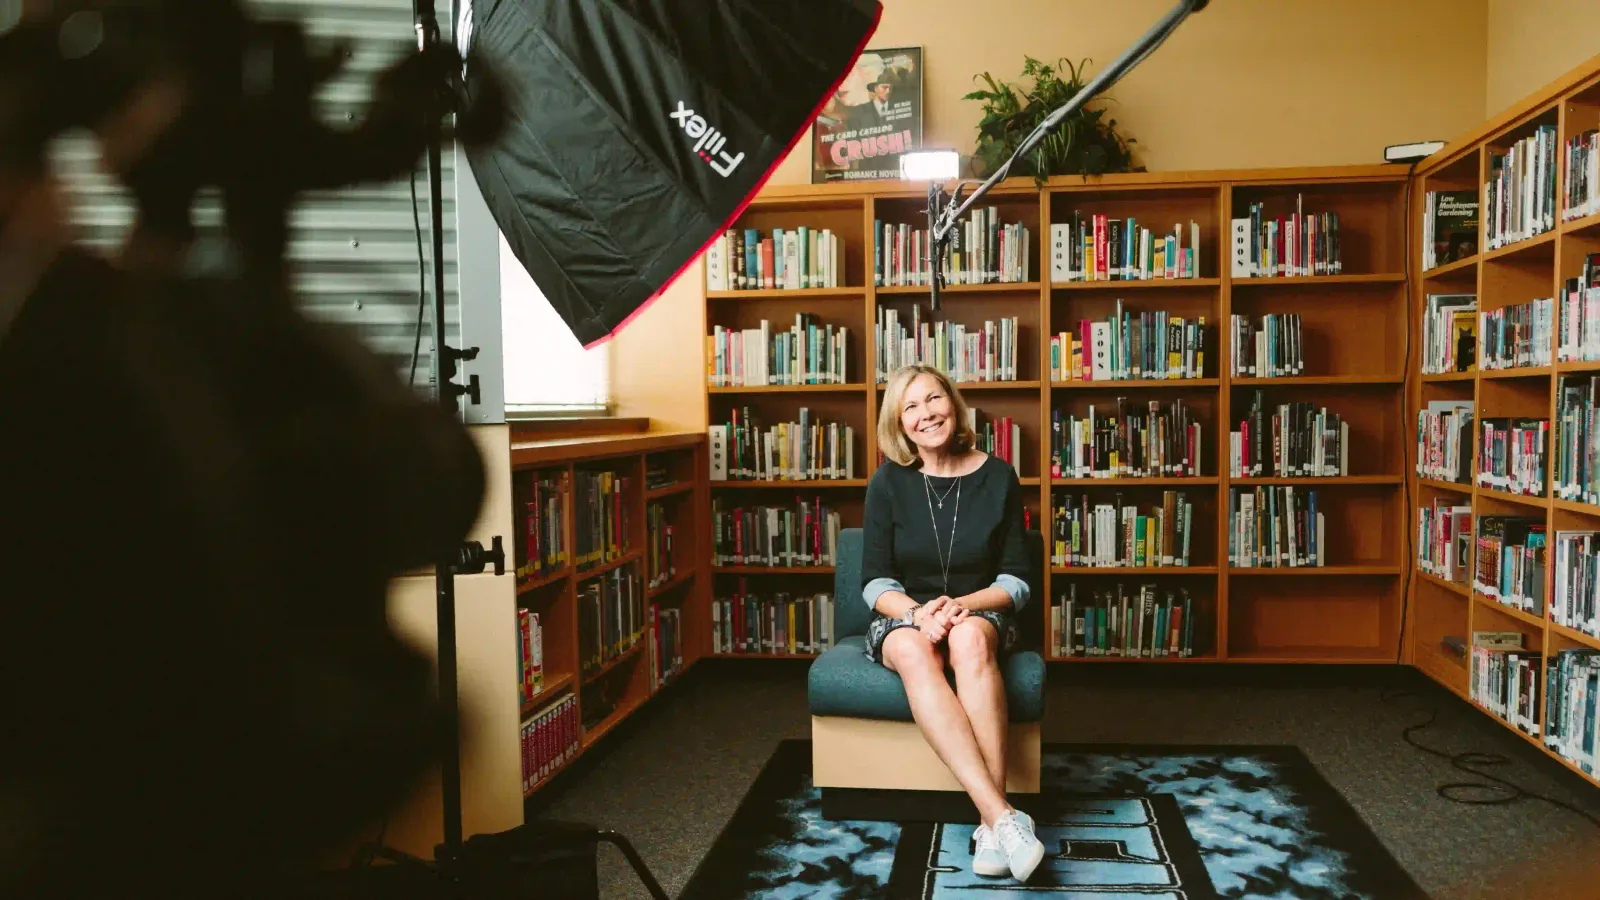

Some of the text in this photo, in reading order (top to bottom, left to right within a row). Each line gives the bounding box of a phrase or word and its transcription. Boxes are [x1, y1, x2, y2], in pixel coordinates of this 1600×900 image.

[669, 100, 745, 178] Fiilex
[821, 124, 893, 143] THE CARD CATALOG
[830, 129, 912, 170] CRUSH!
[844, 170, 878, 179] ROMANCE
[879, 169, 901, 178] NOVE
[1438, 209, 1474, 217] Gardening
[1439, 202, 1479, 210] Maintenanc
